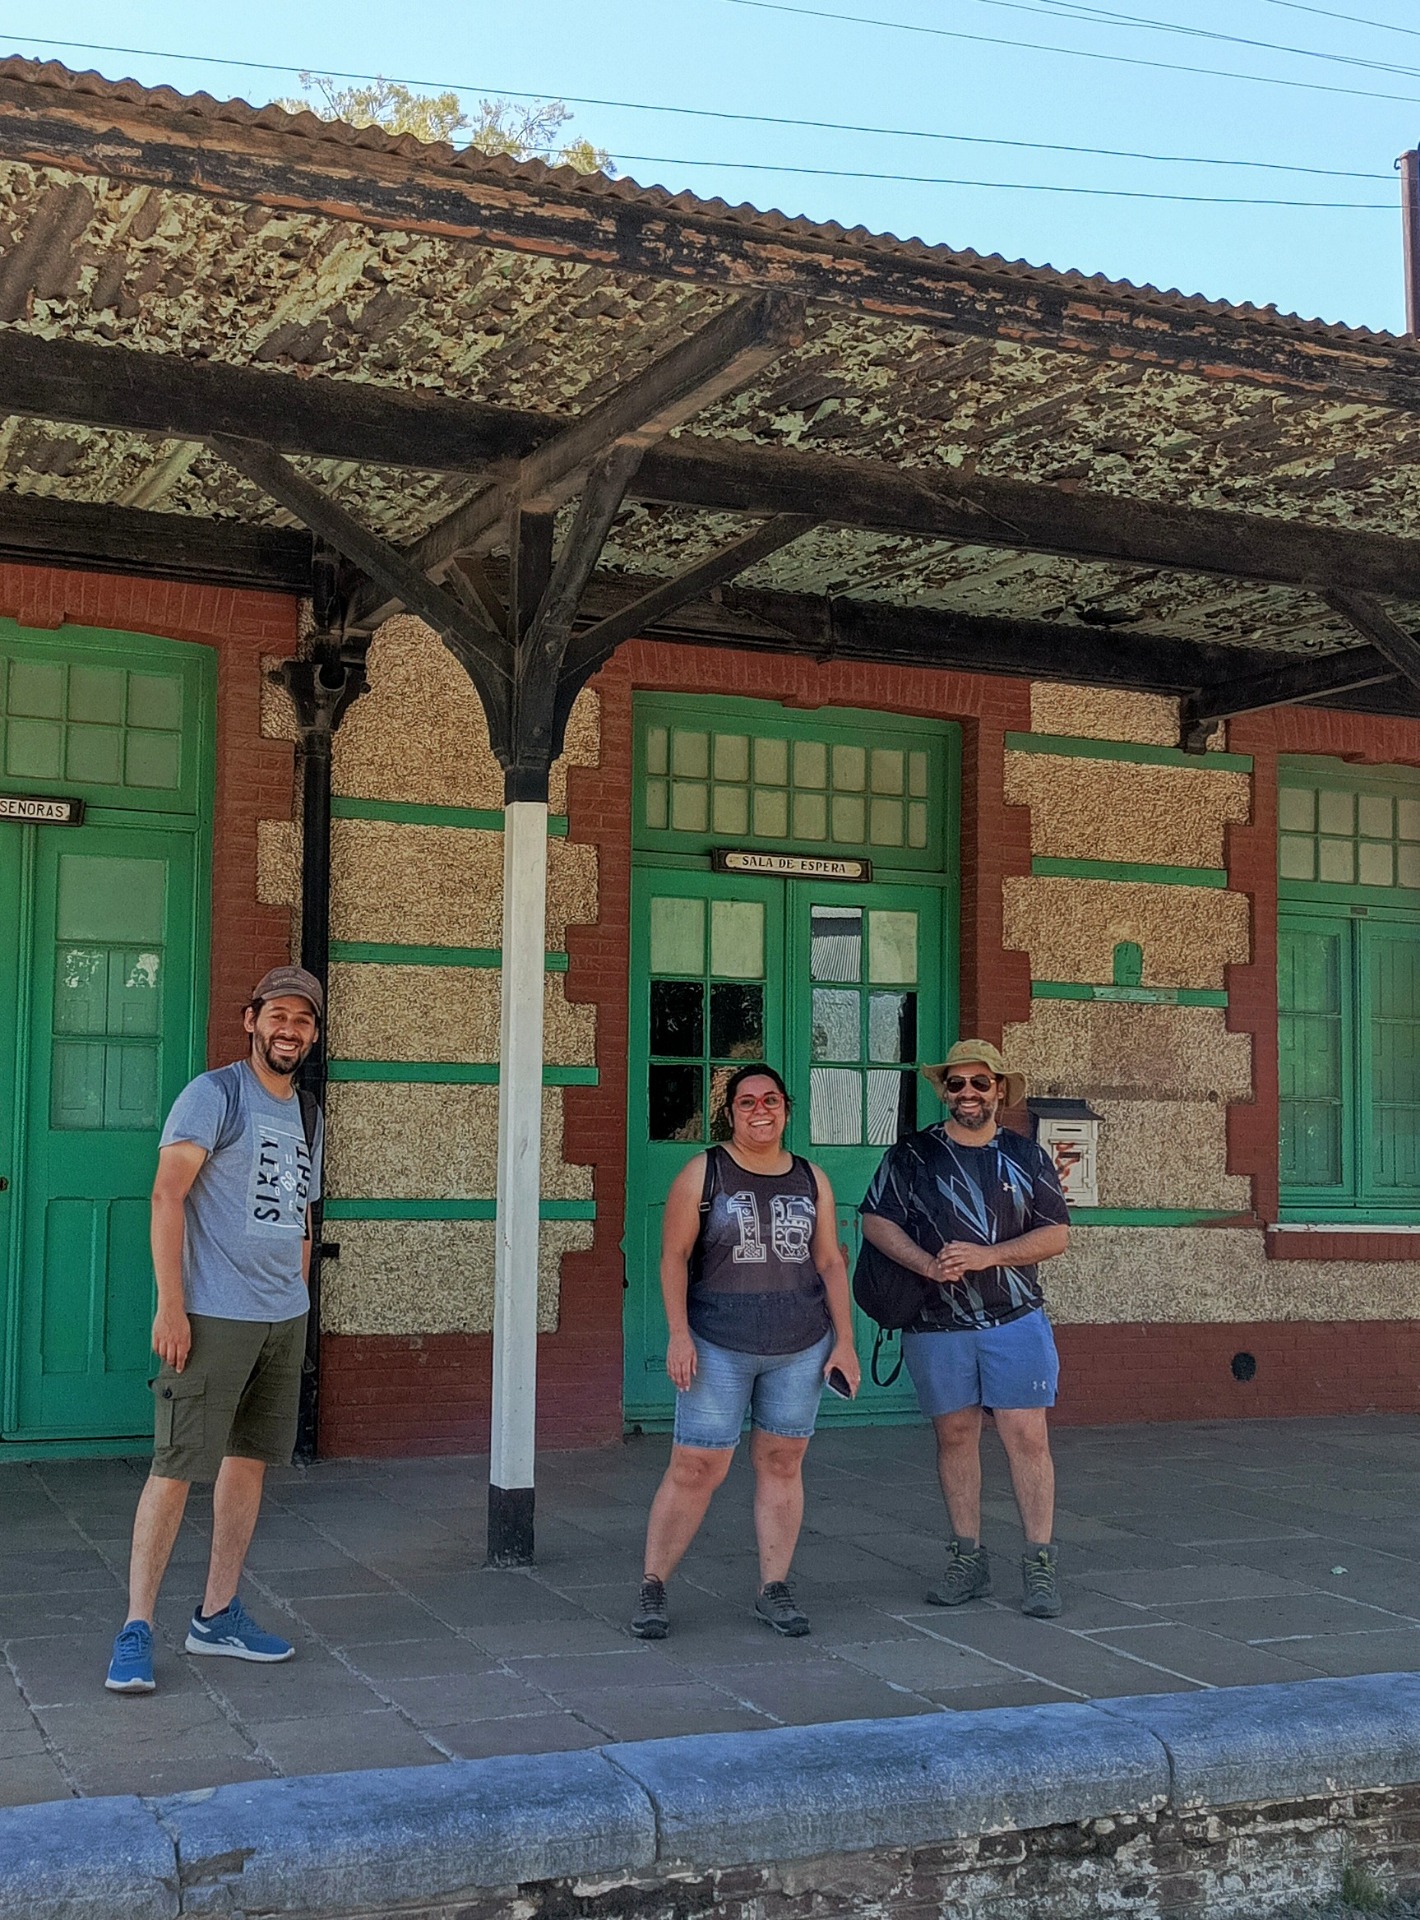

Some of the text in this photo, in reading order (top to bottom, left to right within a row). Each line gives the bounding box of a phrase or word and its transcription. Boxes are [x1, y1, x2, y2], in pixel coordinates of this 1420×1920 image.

[742, 855, 846, 874] SALA DE ESPERA
[254, 1136, 281, 1222] SIXTY
[726, 1191, 816, 1264] 16
